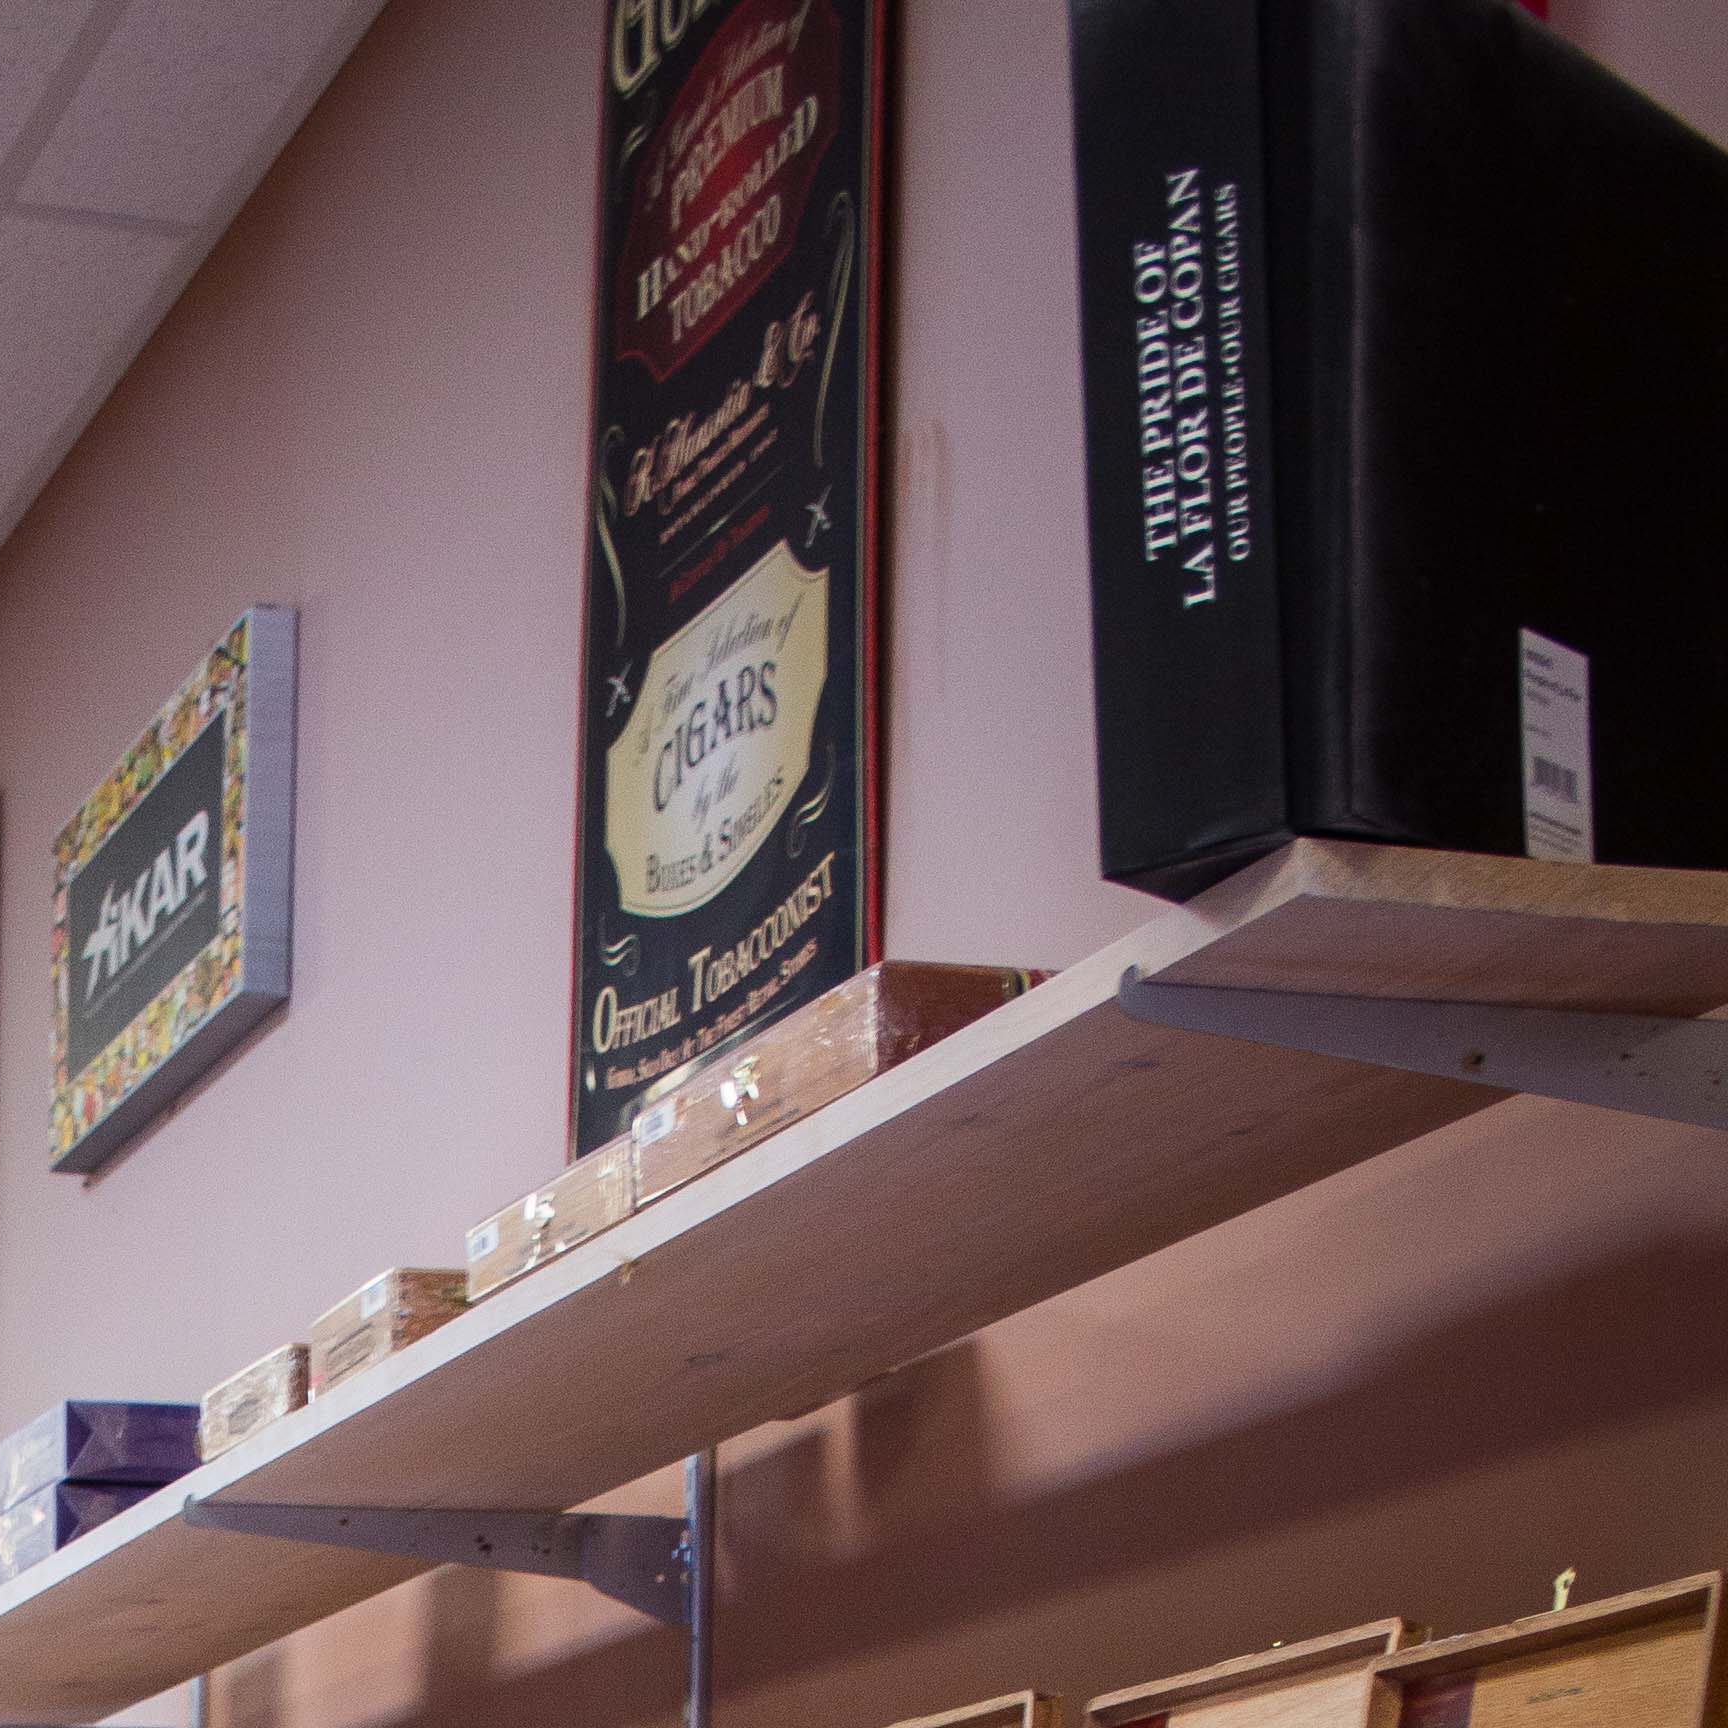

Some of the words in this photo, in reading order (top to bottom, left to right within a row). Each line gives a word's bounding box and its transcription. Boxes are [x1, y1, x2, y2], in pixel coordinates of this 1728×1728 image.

[668, 195, 781, 342] TOBACCO
[1133, 240, 1168, 304] OF
[1165, 166, 1205, 330] COPAN
[1213, 182, 1241, 293] CIGARS
[1136, 310, 1172, 455] PRIDE
[1174, 334, 1207, 402] DE
[1143, 460, 1177, 562] THE
[1176, 406, 1213, 536] FLOR
[1226, 492, 1251, 563] OUR
[1183, 544, 1217, 609] LA
[652, 659, 779, 813] CIGARS
[592, 985, 683, 1054] OFFICIAL
[687, 850, 836, 1014] TOBACCONIST
